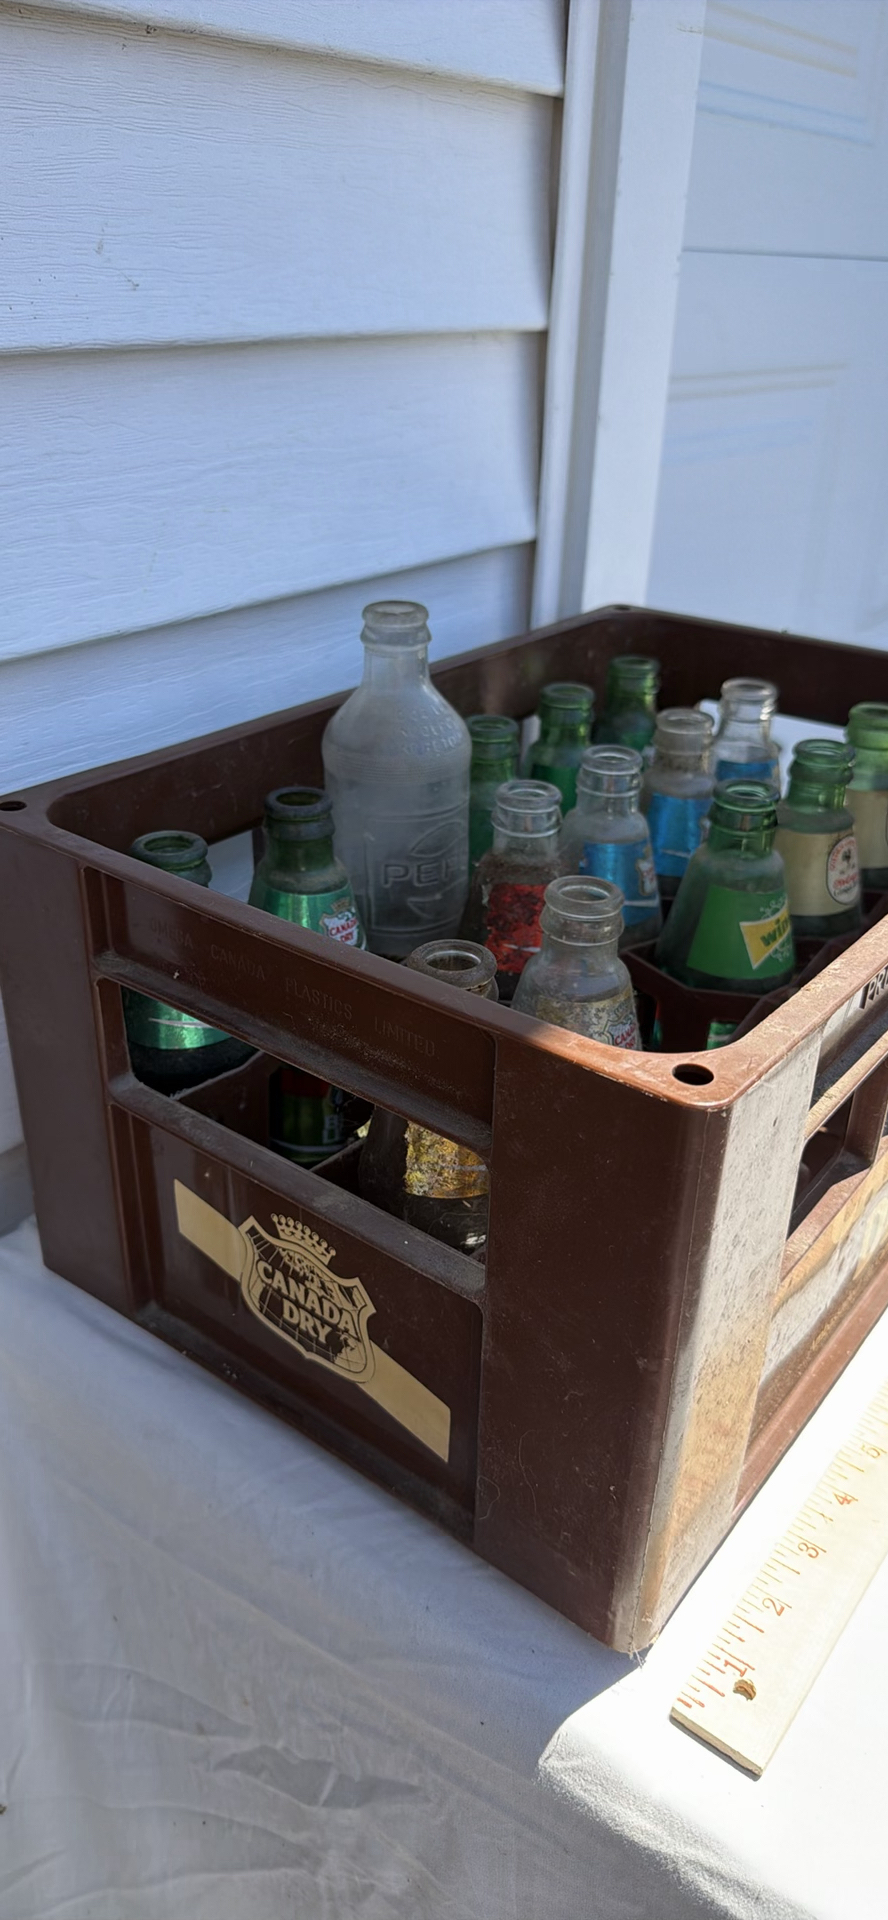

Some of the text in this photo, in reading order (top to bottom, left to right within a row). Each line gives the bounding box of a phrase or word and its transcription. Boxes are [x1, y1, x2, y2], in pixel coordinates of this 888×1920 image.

[760, 917, 790, 947] win
[210, 943, 265, 980] CANADA
[284, 977, 353, 1021] PLASTICS
[374, 1016, 435, 1057] LIMITED
[256, 1260, 356, 1337] CANADA
[282, 1301, 333, 1343] DRY
[860, 1444, 882, 1459] 5
[833, 1491, 853, 1507] 4
[798, 1542, 820, 1559] 3
[762, 1597, 785, 1617] 2
[723, 1658, 748, 1677] 1
